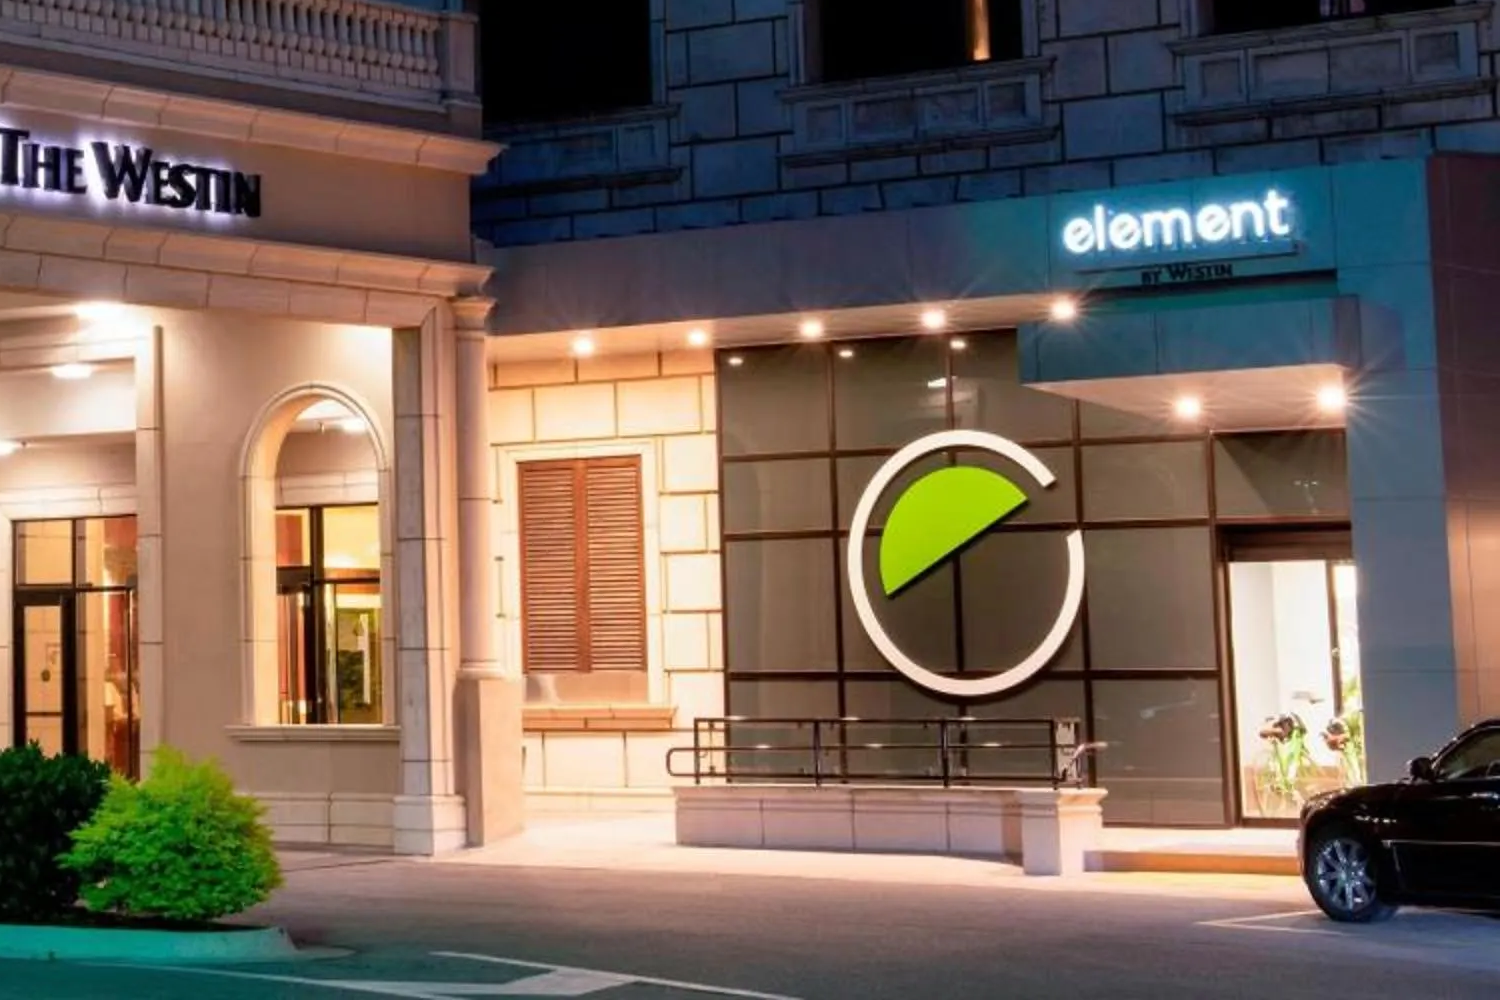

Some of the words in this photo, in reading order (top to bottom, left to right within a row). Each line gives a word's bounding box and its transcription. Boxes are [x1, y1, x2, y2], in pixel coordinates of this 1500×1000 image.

[90, 141, 262, 218] WESTIN
[1062, 188, 1290, 254] element
[1166, 263, 1234, 281] WESTIN
